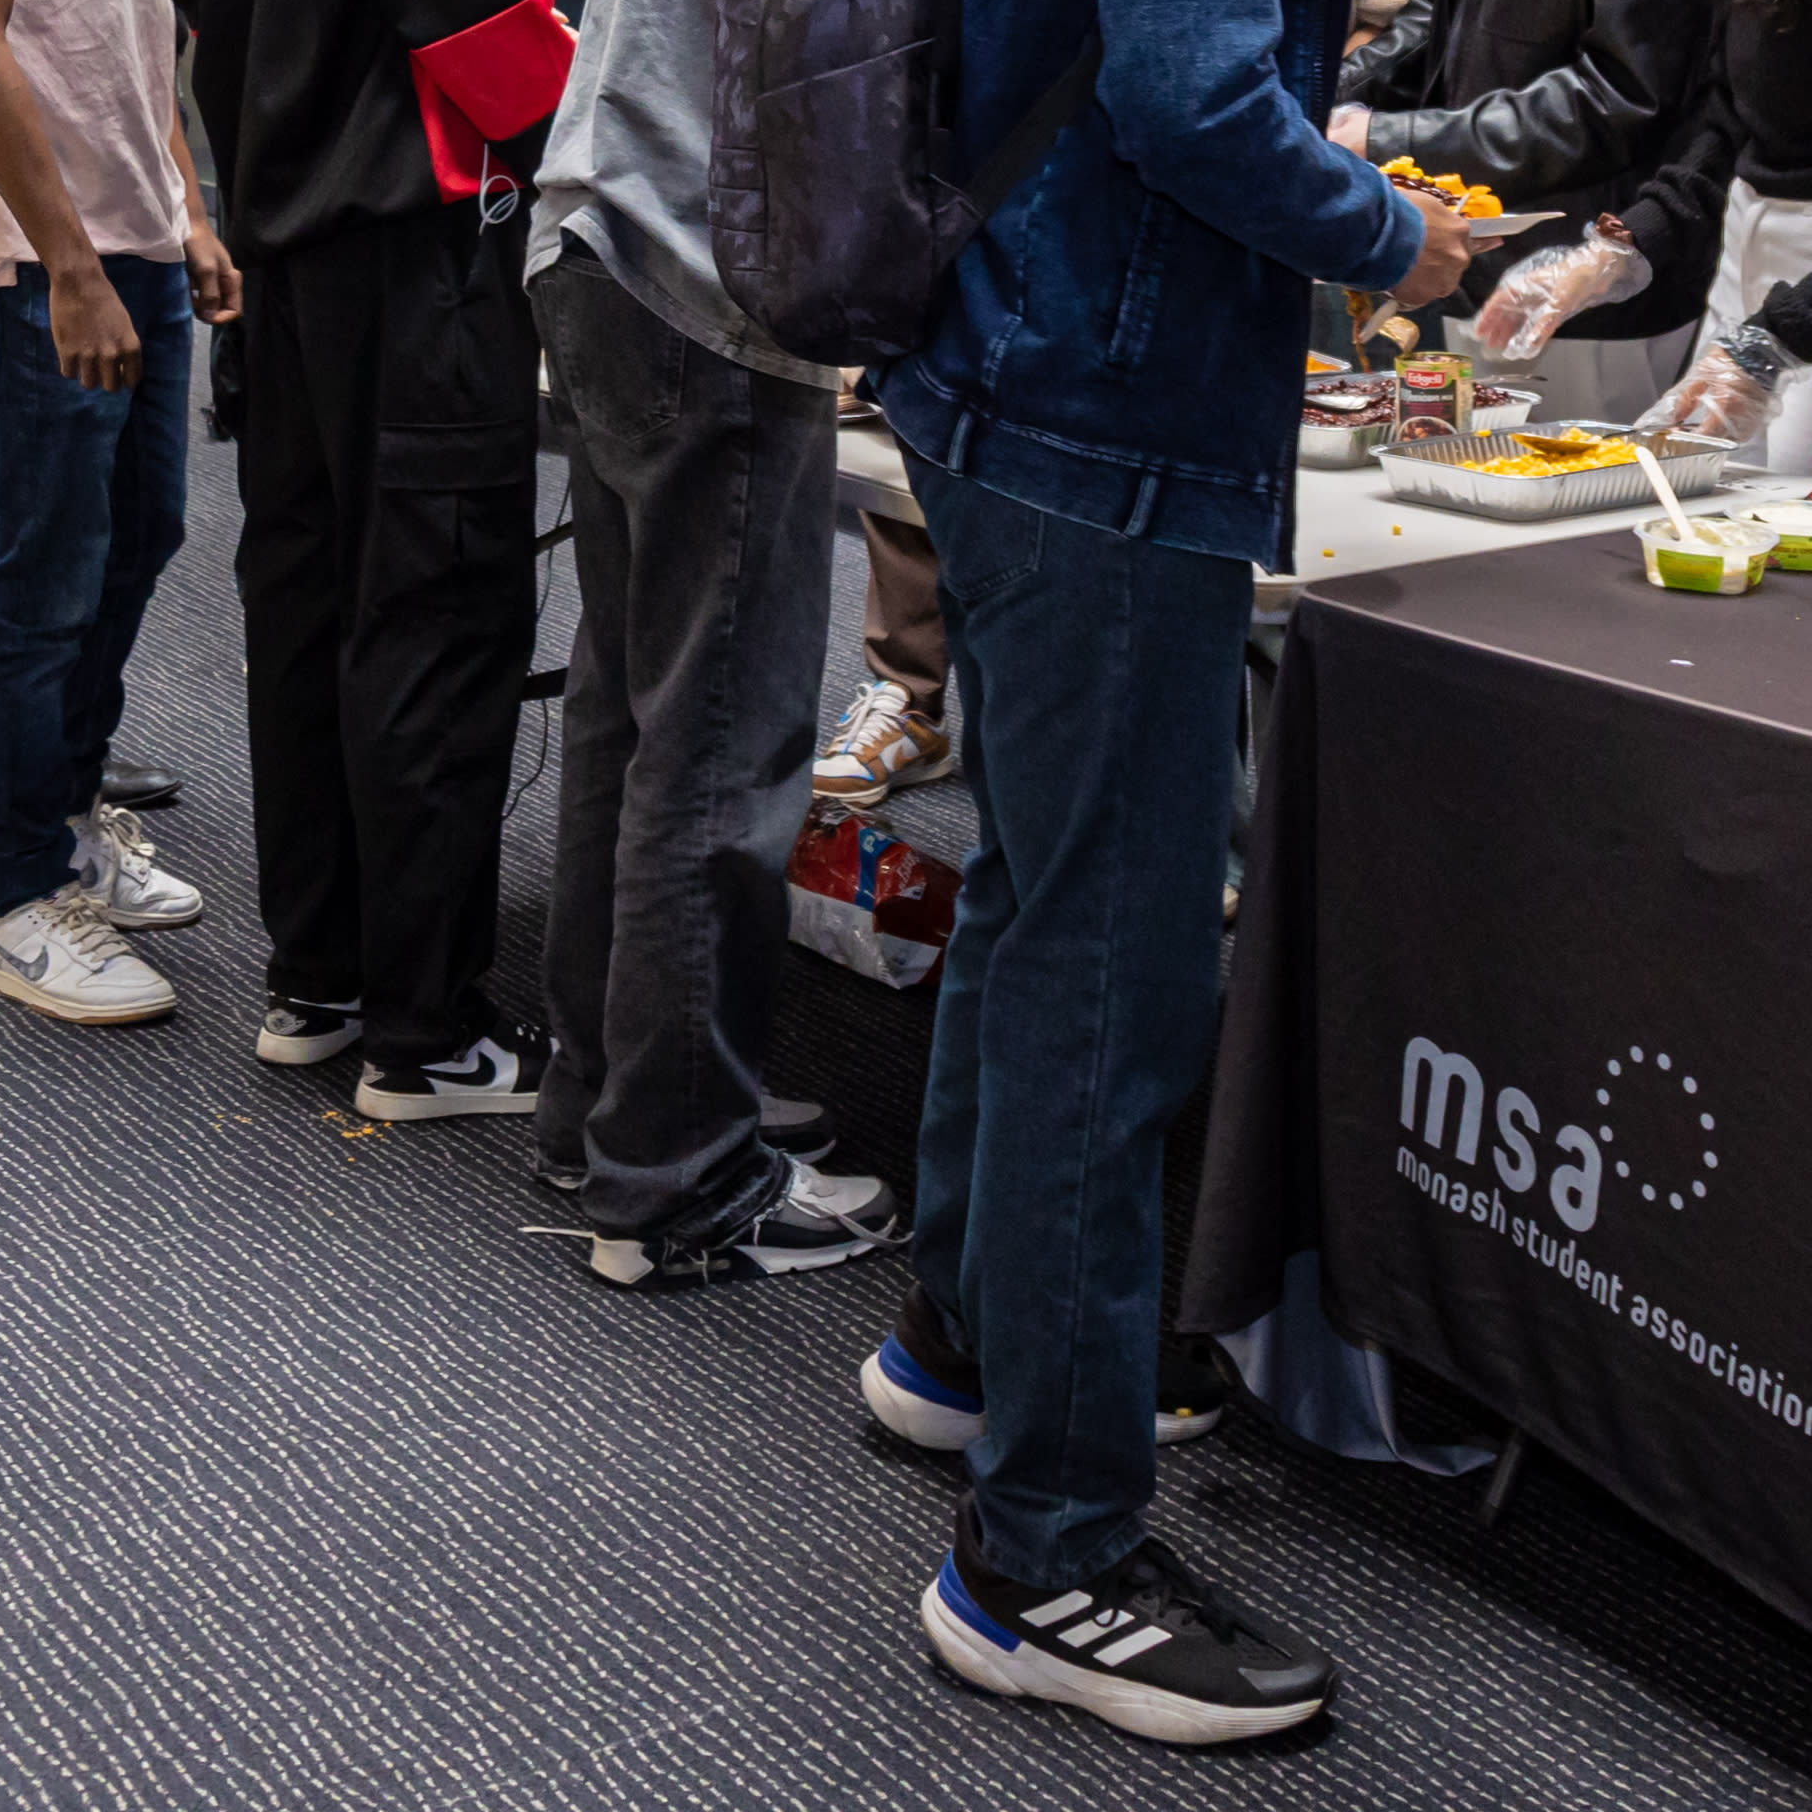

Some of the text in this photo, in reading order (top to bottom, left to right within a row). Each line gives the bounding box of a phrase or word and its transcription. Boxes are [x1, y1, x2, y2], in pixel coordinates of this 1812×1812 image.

[1400, 1035, 1602, 1233] msa
[1396, 1145, 1506, 1234] monash
[1512, 1218, 1623, 1315] student
